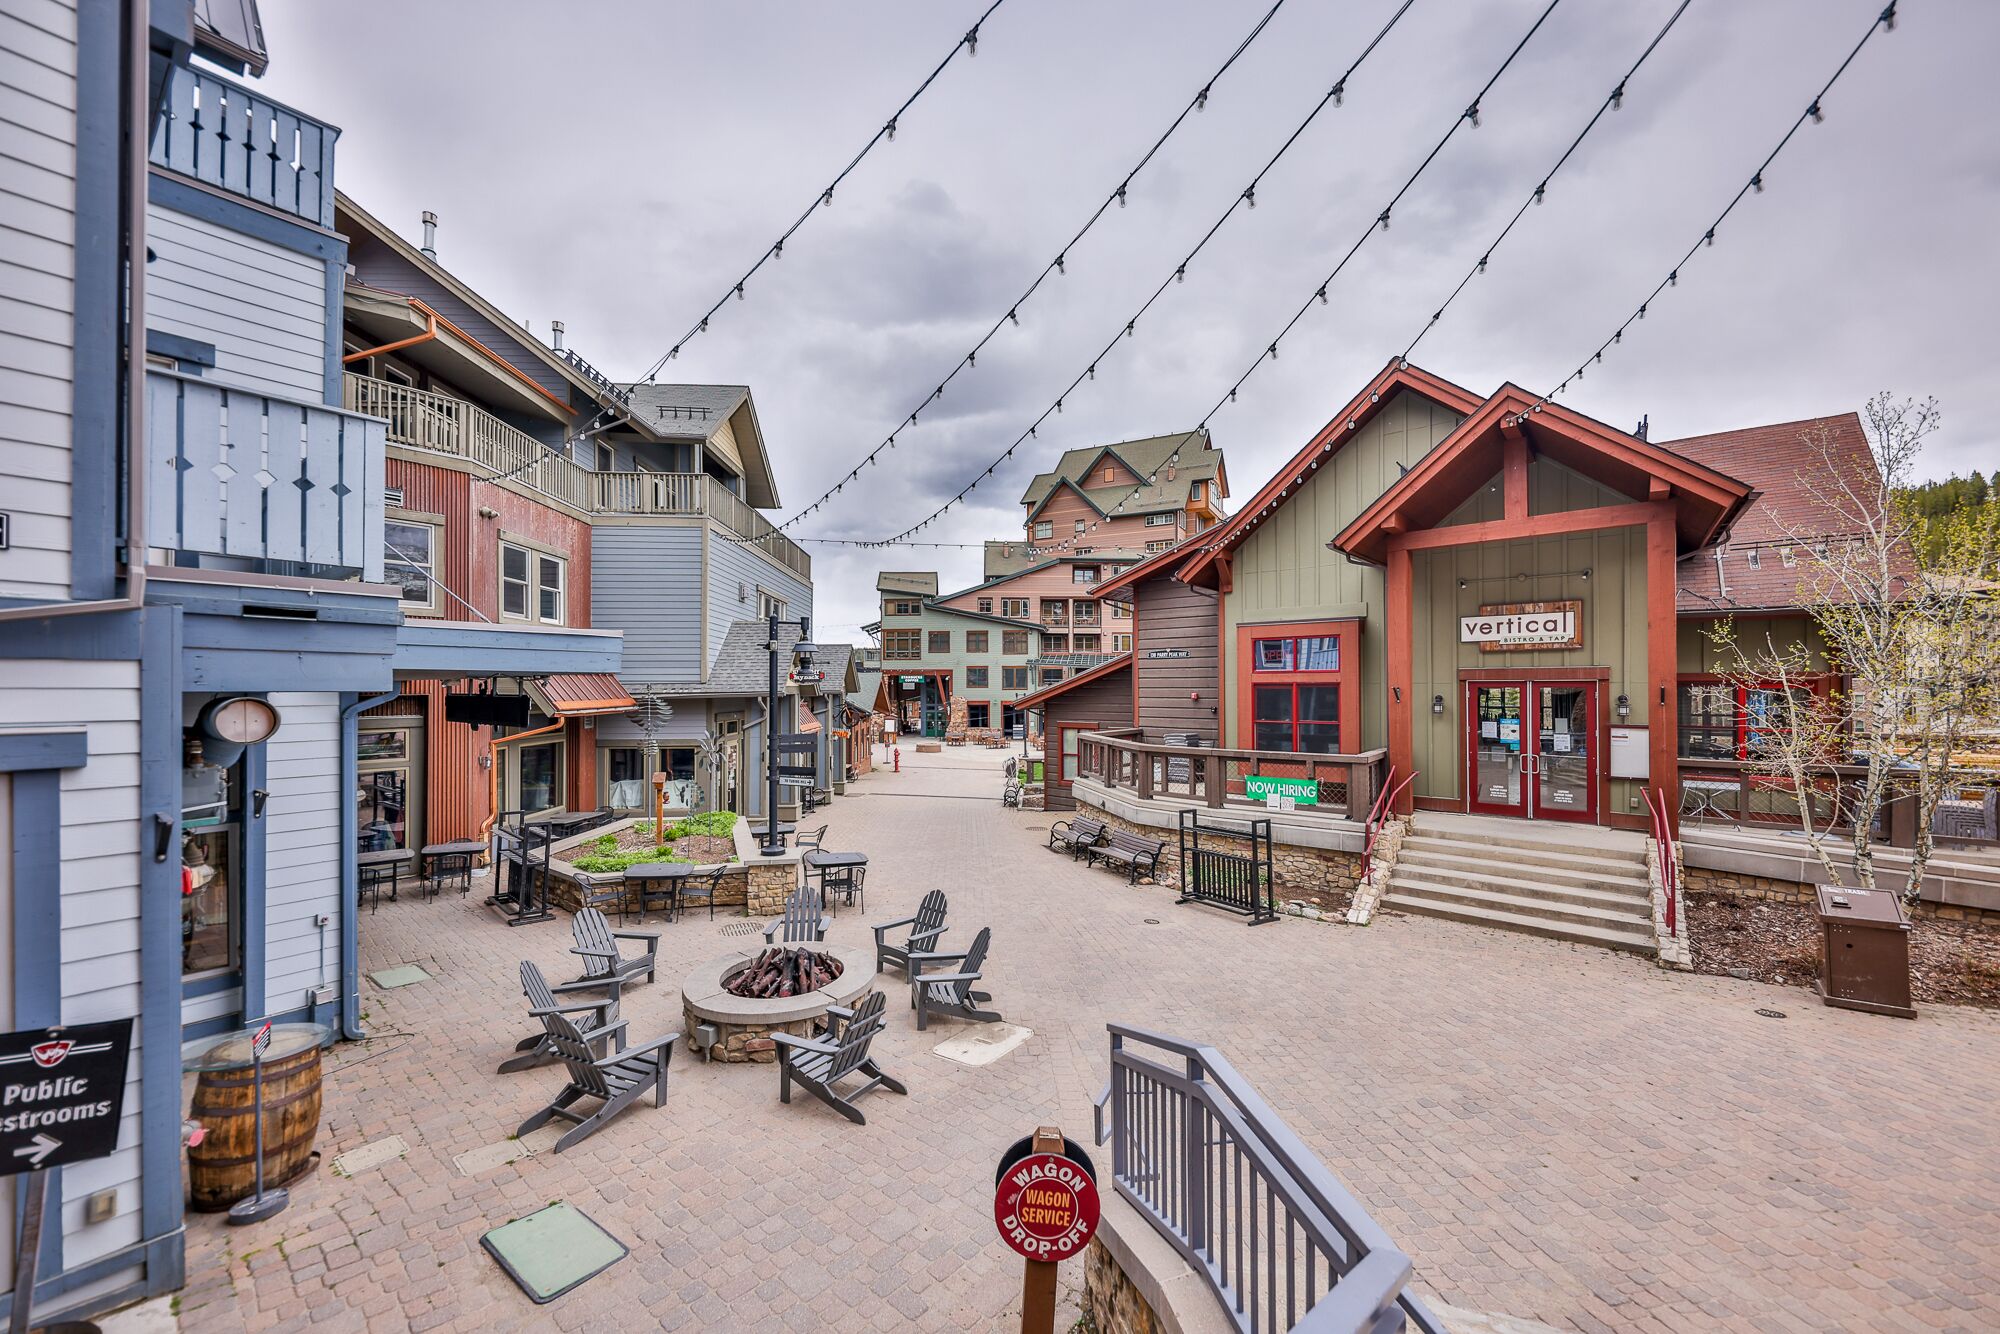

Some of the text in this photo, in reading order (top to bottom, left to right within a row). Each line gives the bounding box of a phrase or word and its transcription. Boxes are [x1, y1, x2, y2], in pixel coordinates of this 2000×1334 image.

[1465, 609, 1567, 635] vertical
[1247, 781, 1316, 798] NOW HIRING
[3, 1076, 88, 1106] Public
[0, 1100, 112, 1132] strooms
[1011, 1163, 1087, 1193] WAGON
[1026, 1189, 1071, 1208] WAGON
[1021, 1207, 1071, 1227] SERVICE
[1002, 1214, 1089, 1254] DROP-OFF
